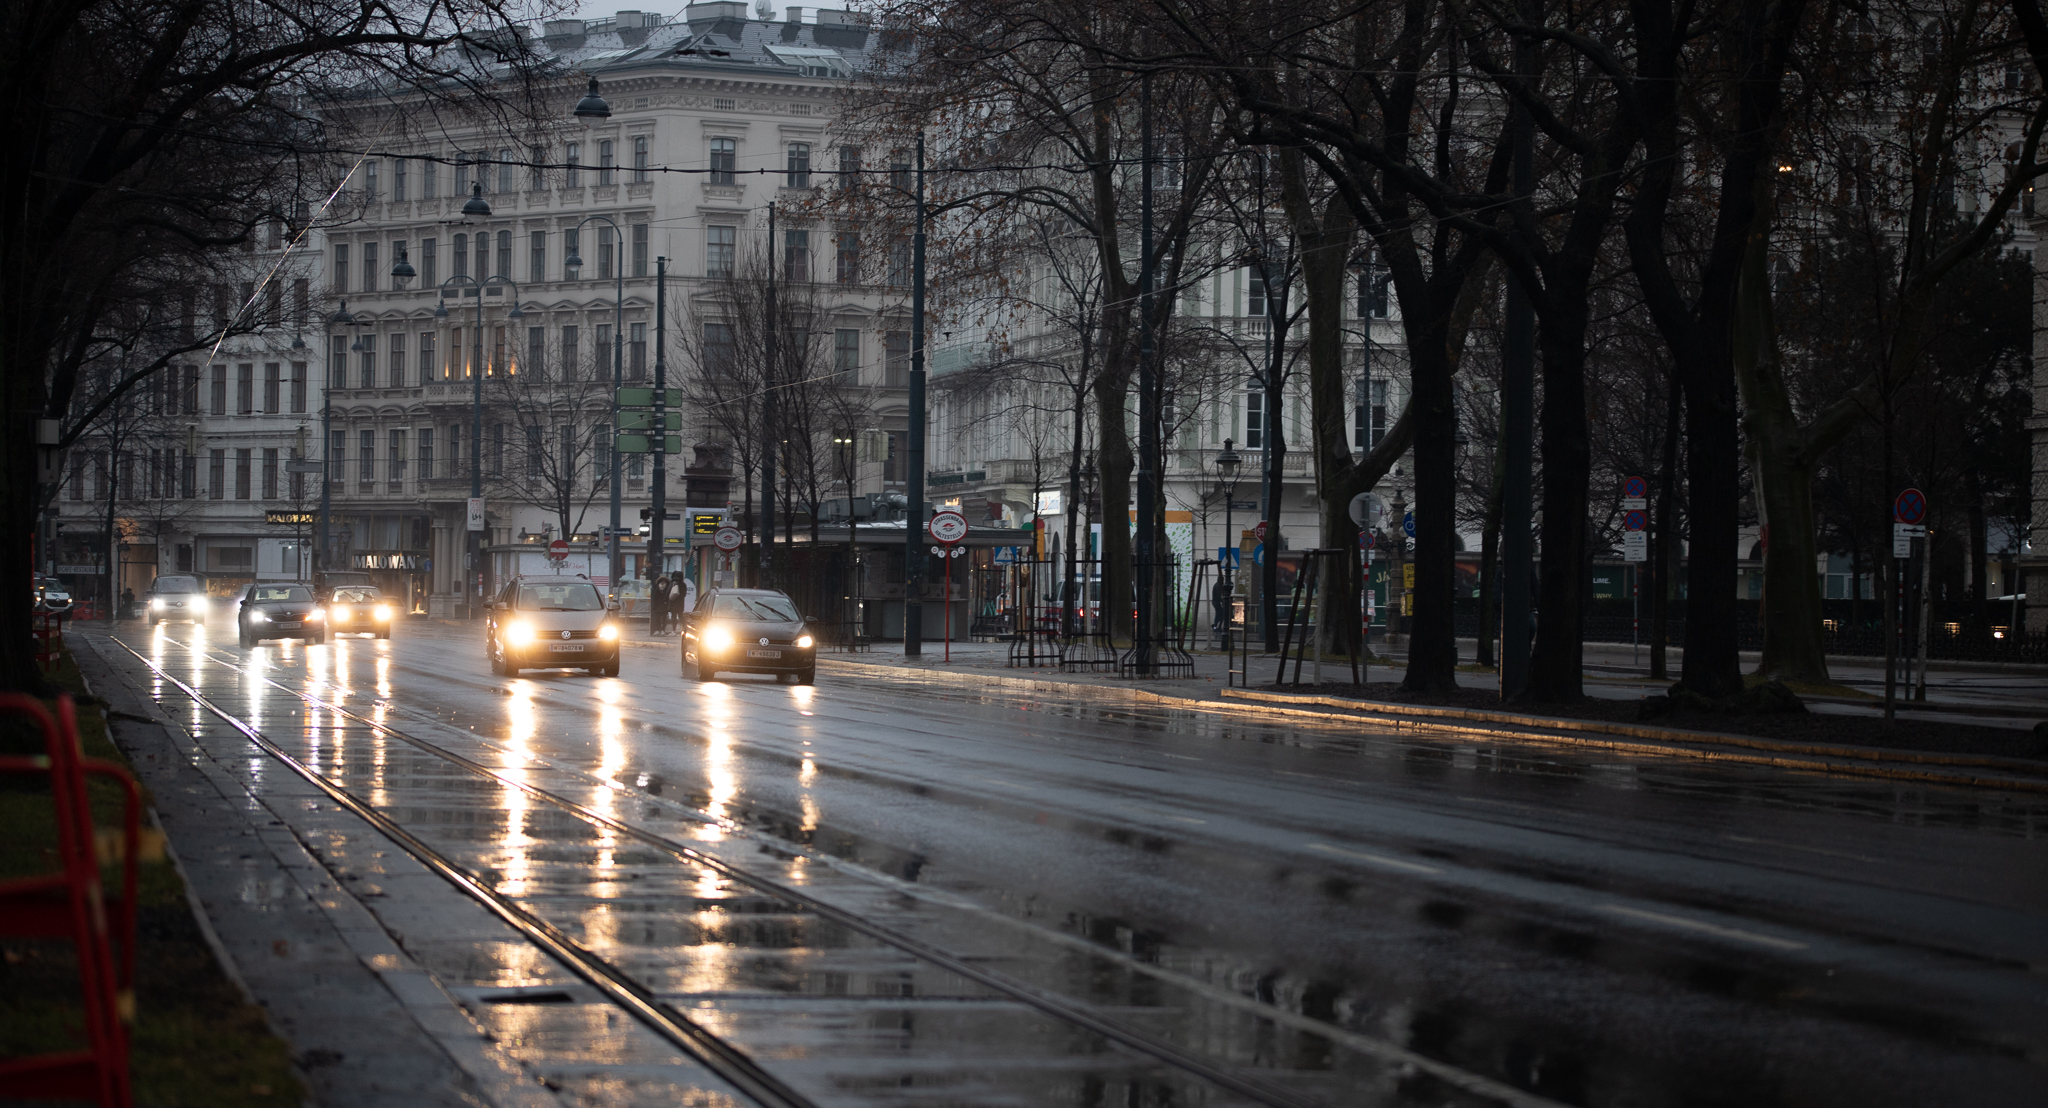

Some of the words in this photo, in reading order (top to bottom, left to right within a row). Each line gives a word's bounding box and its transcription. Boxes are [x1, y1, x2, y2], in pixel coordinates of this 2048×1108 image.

[267, 514, 313, 523] MALOWAN
[933, 515, 964, 526] STRASSENBAHN
[934, 530, 962, 539] HALTESTELLE
[1257, 527, 1267, 536] ST
[354, 555, 416, 569] MALOWAN
